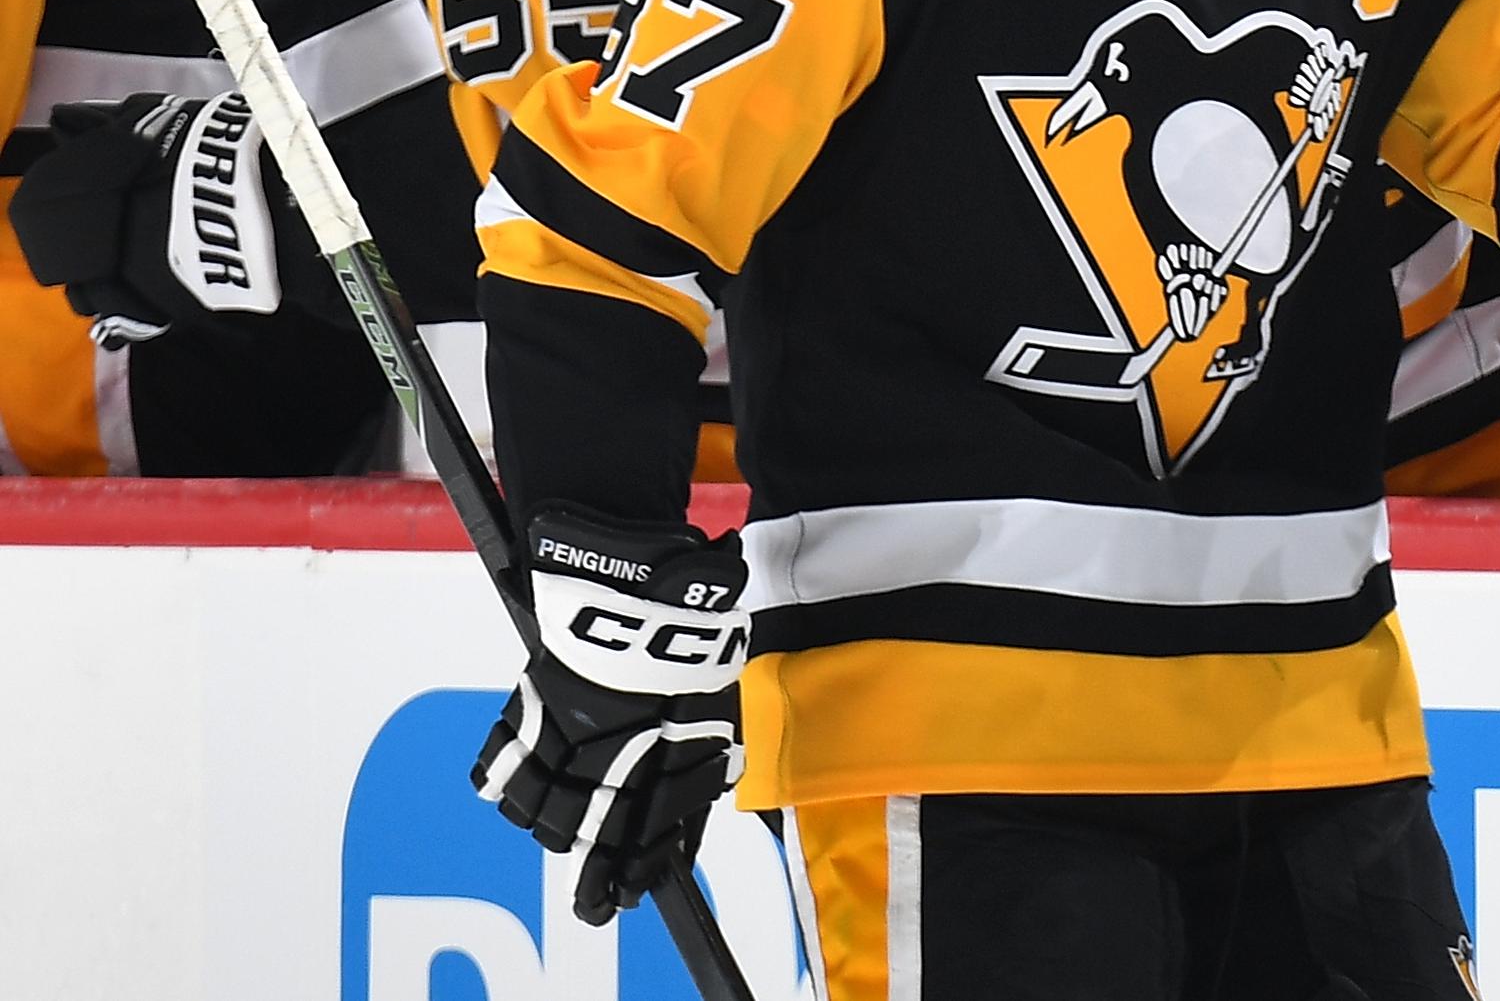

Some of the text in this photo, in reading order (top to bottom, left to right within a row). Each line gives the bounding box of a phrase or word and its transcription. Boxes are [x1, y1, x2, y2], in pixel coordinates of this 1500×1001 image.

[339, 270, 412, 388] CCM
[538, 538, 652, 582] PENGUINS
[683, 583, 730, 608] 87
